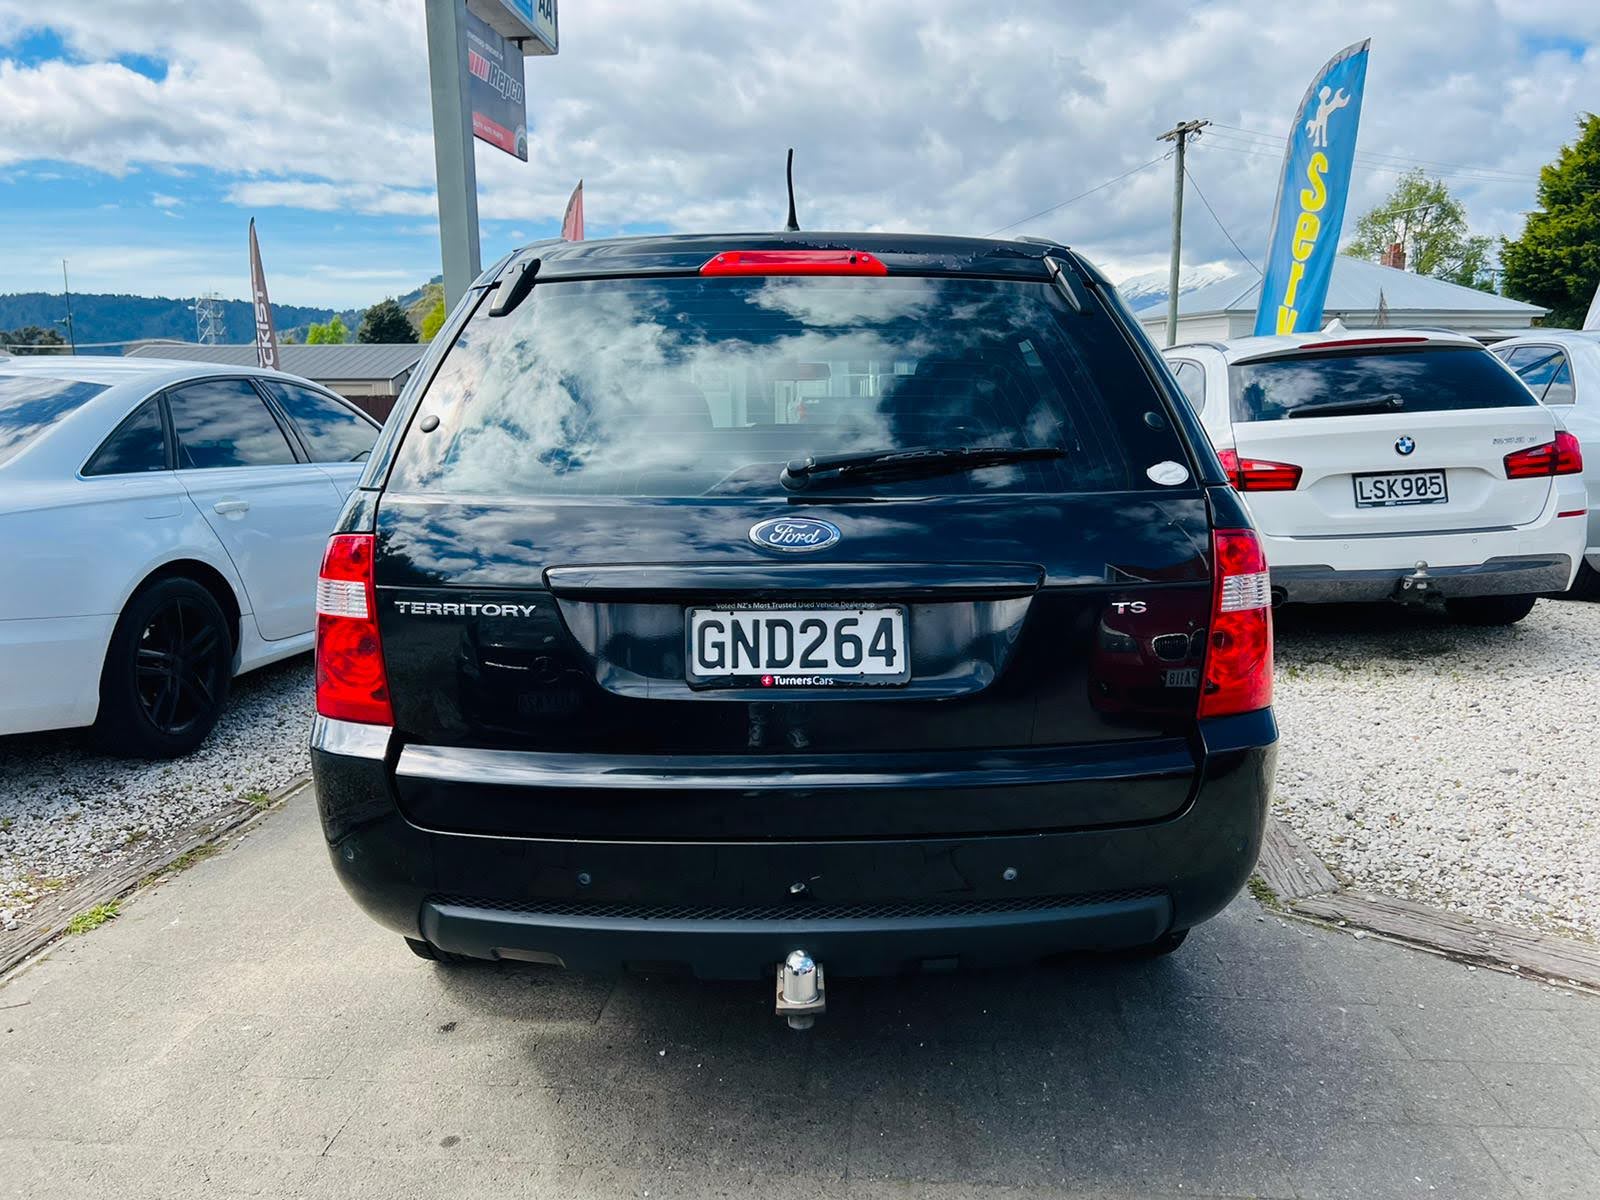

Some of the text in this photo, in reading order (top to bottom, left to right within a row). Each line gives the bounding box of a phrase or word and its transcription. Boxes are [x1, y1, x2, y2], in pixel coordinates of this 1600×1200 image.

[488, 60, 523, 105] Repco
[1358, 475, 1442, 500] LSK905
[769, 523, 820, 544] Ford
[394, 600, 536, 617] TERRITORY
[798, 601, 815, 609] Used
[816, 601, 839, 609] Vehicle
[840, 601, 876, 609] Dealership
[1111, 600, 1147, 614] TS
[697, 617, 897, 669] GND264
